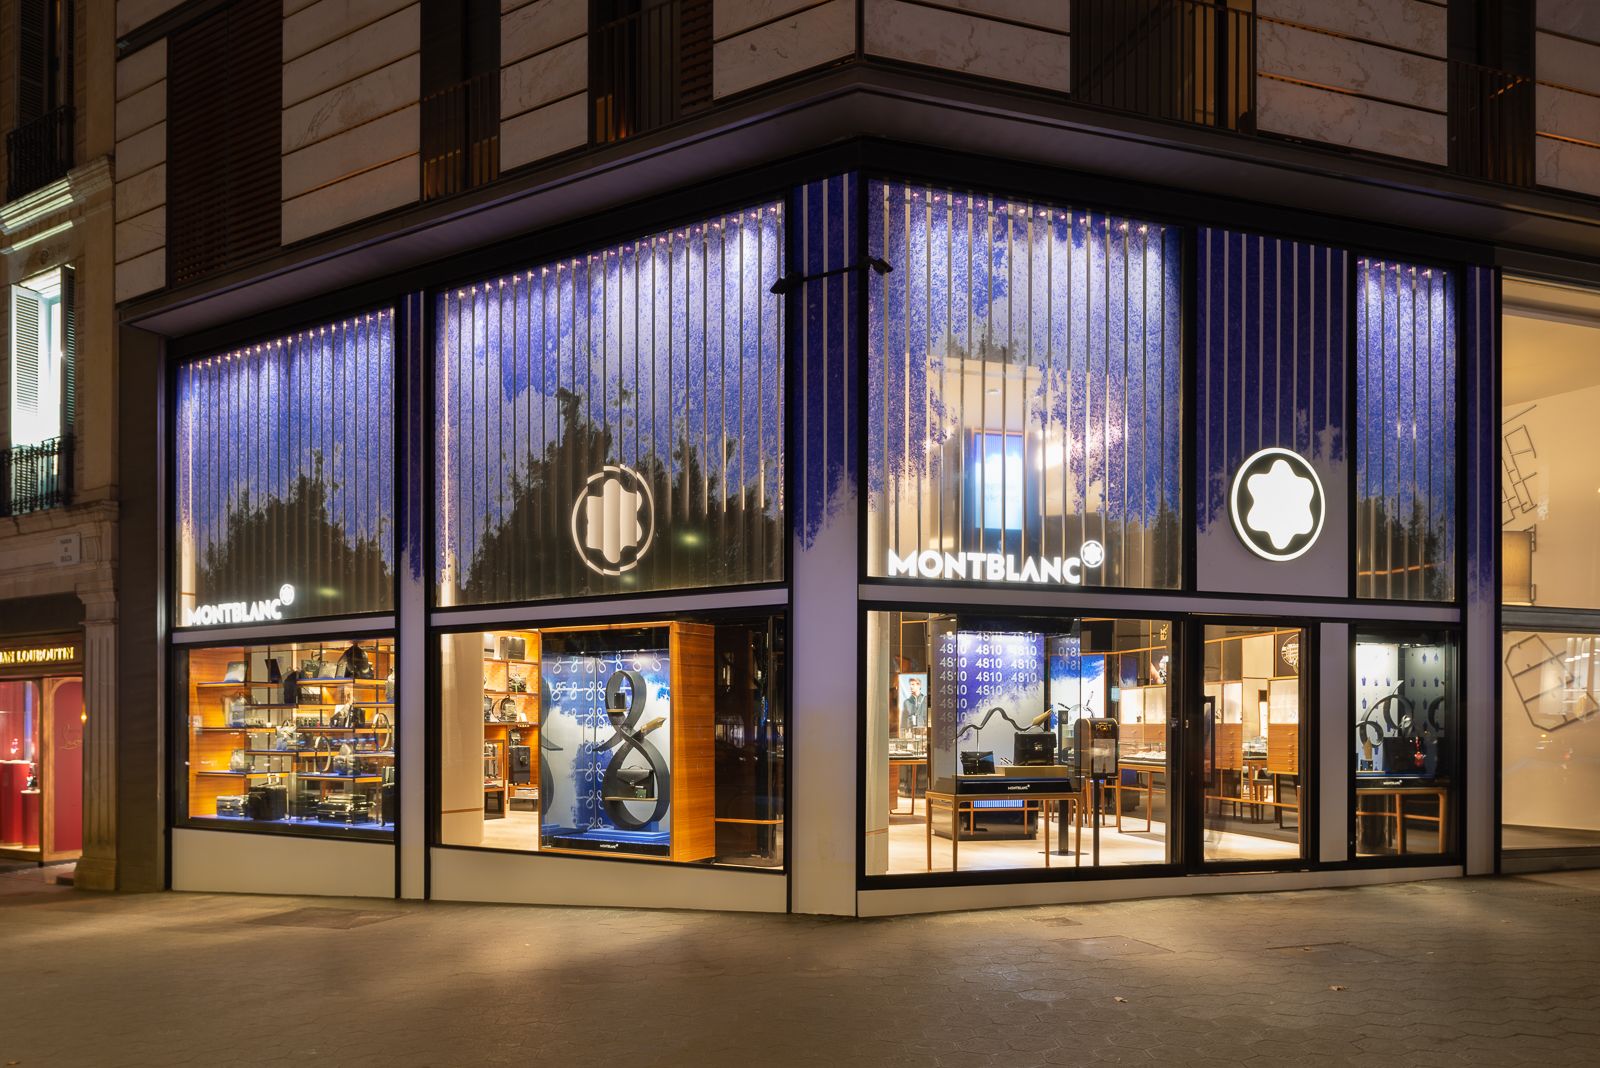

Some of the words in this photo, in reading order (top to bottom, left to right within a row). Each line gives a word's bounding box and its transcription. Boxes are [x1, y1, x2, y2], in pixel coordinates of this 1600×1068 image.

[888, 549, 1080, 584] MONTBLANC
[187, 599, 282, 625] MONTBLANC
[976, 644, 1003, 655] 4810
[976, 658, 1003, 669] 4810
[1010, 659, 1037, 670] 4810
[976, 671, 1003, 682] 4810
[1010, 672, 1037, 683] 4810
[976, 685, 1003, 695] 4810
